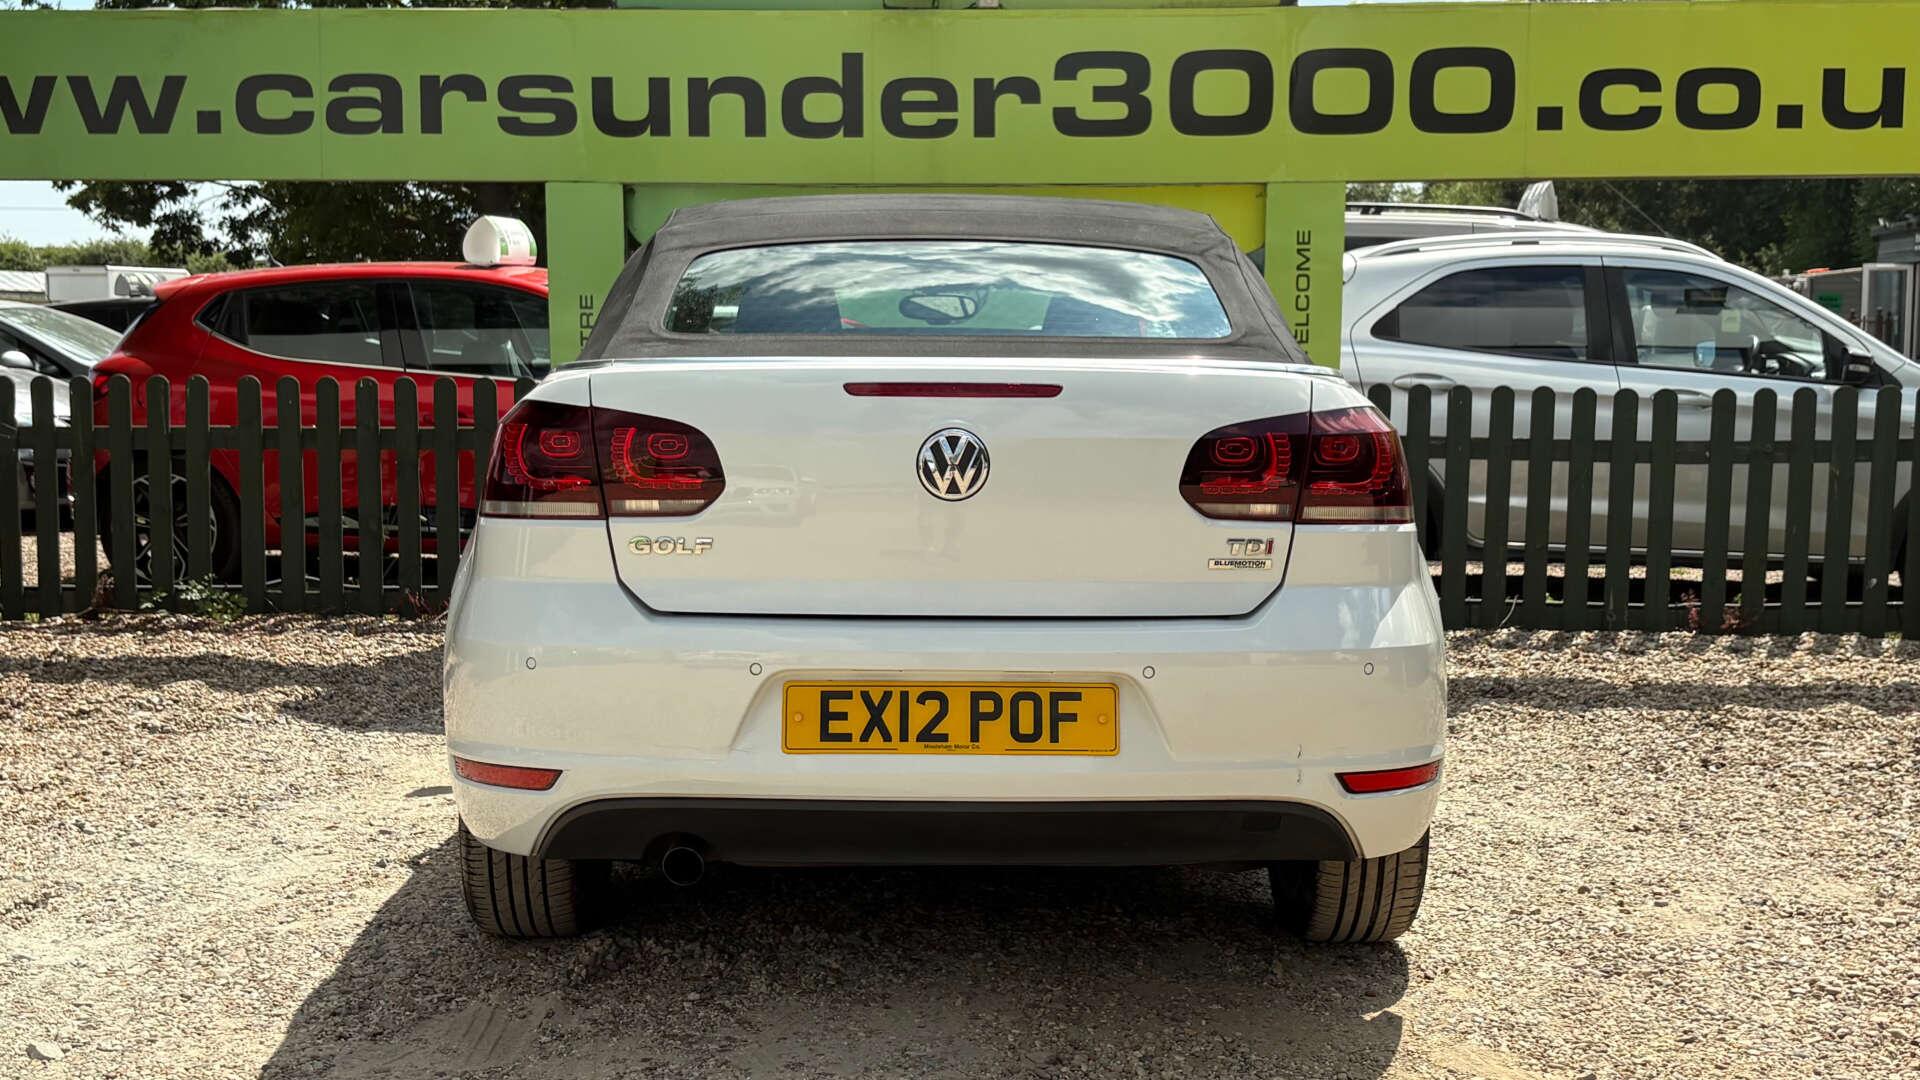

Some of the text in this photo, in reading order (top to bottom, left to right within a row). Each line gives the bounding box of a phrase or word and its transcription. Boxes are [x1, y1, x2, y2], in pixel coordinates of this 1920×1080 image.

[1294, 230, 1311, 352] ELCOME
[628, 536, 713, 554] GOLF
[819, 690, 1082, 744] EX12 POF
